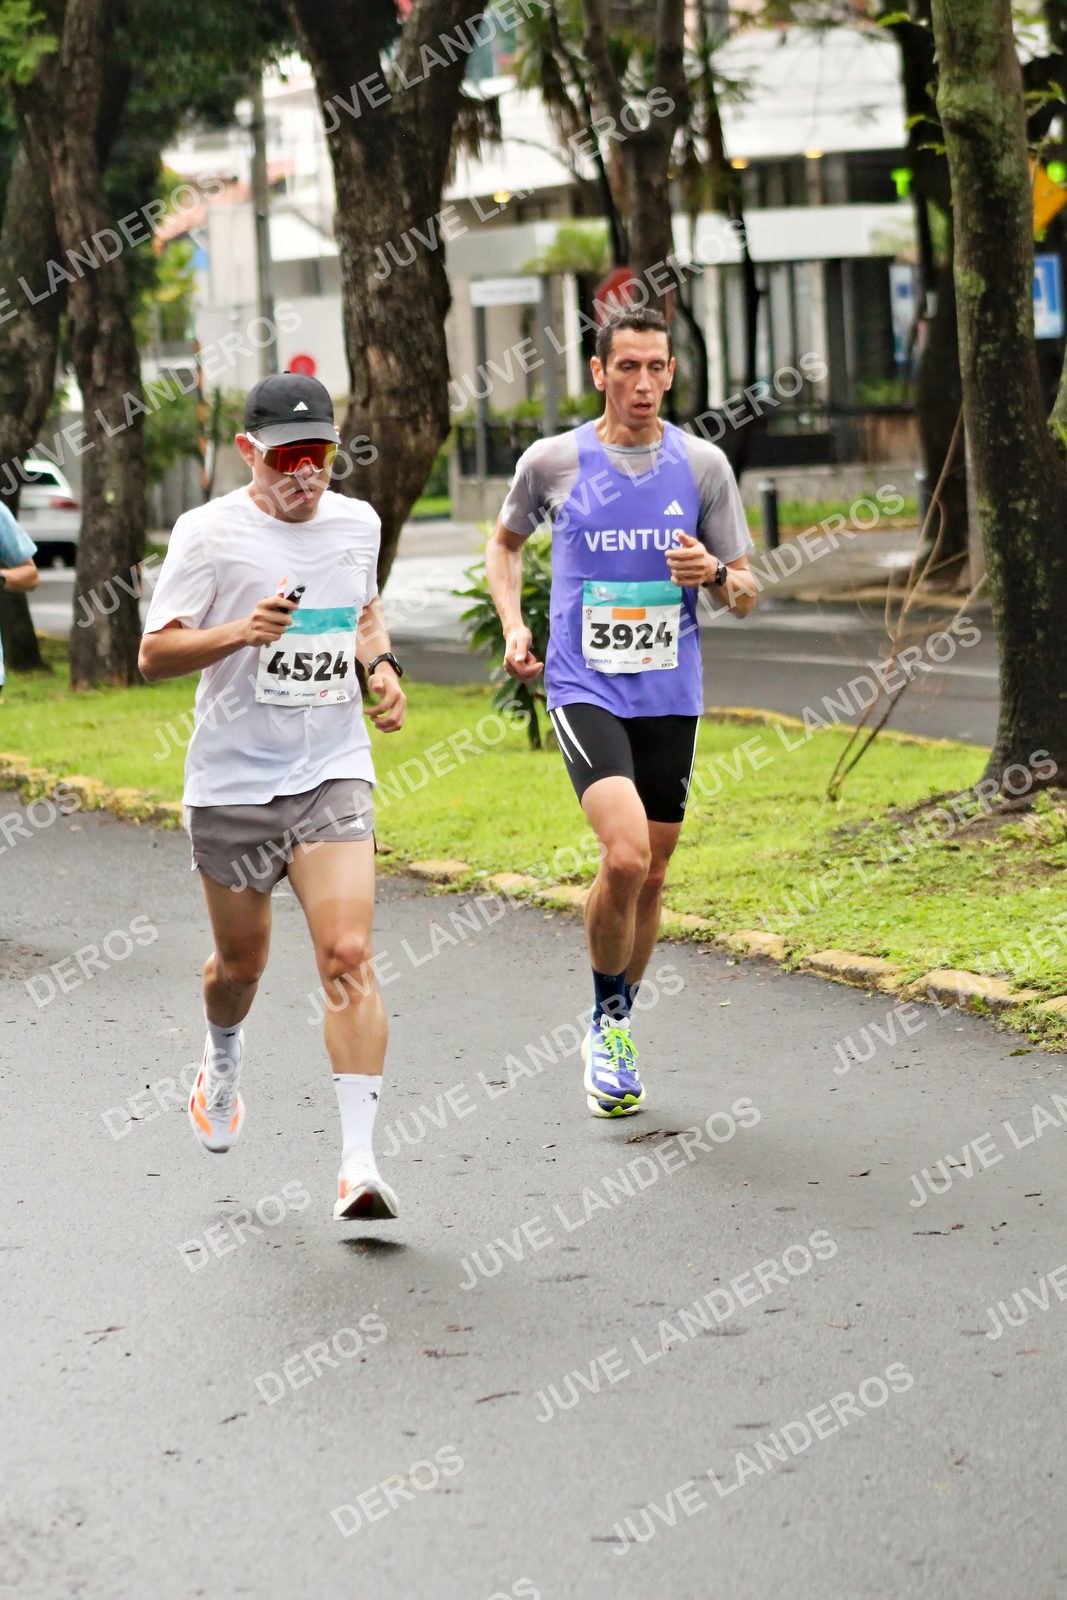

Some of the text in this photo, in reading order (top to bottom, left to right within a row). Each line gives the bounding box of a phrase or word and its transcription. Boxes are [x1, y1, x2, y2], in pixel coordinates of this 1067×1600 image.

[584, 528, 683, 552] VENTUS
[589, 621, 673, 651] 3924
[267, 651, 349, 681] 4524
